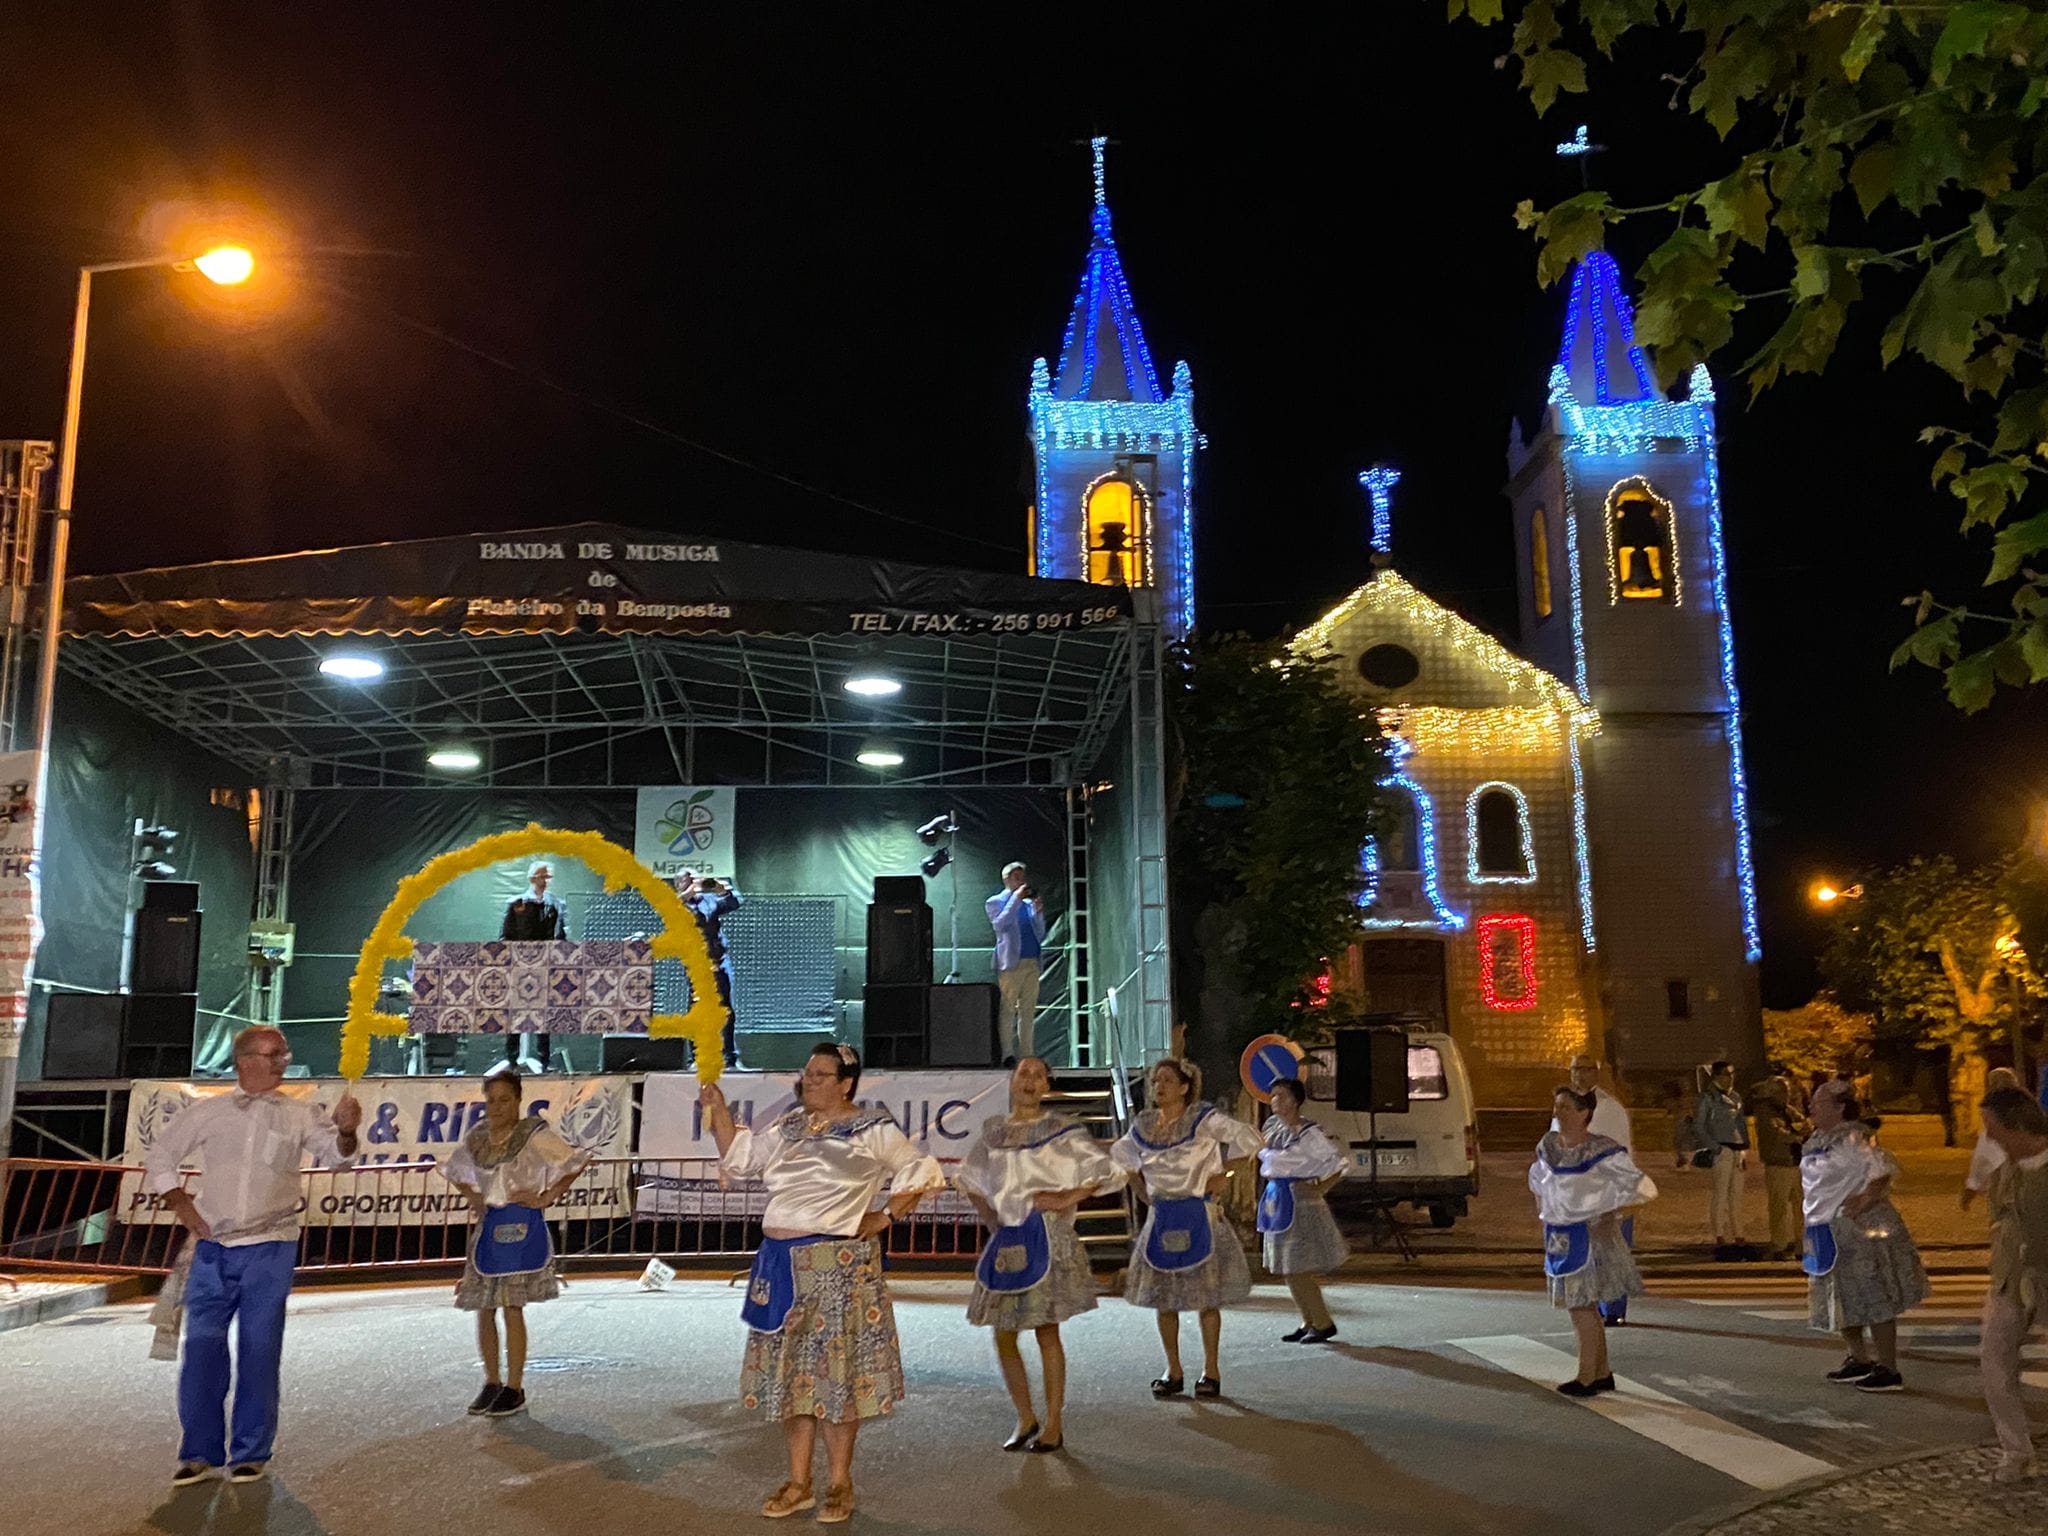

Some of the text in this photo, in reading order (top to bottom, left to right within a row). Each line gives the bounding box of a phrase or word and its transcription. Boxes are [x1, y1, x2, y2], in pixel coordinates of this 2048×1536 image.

[479, 542, 566, 560] BANDA
[577, 542, 614, 560] DE
[588, 570, 617, 588] de
[575, 599, 606, 616] da
[616, 600, 732, 621] Bemposta
[850, 613, 892, 632] TEL
[991, 613, 1030, 632] 256
[1036, 612, 1073, 630] 991
[367, 1102, 400, 1144] &
